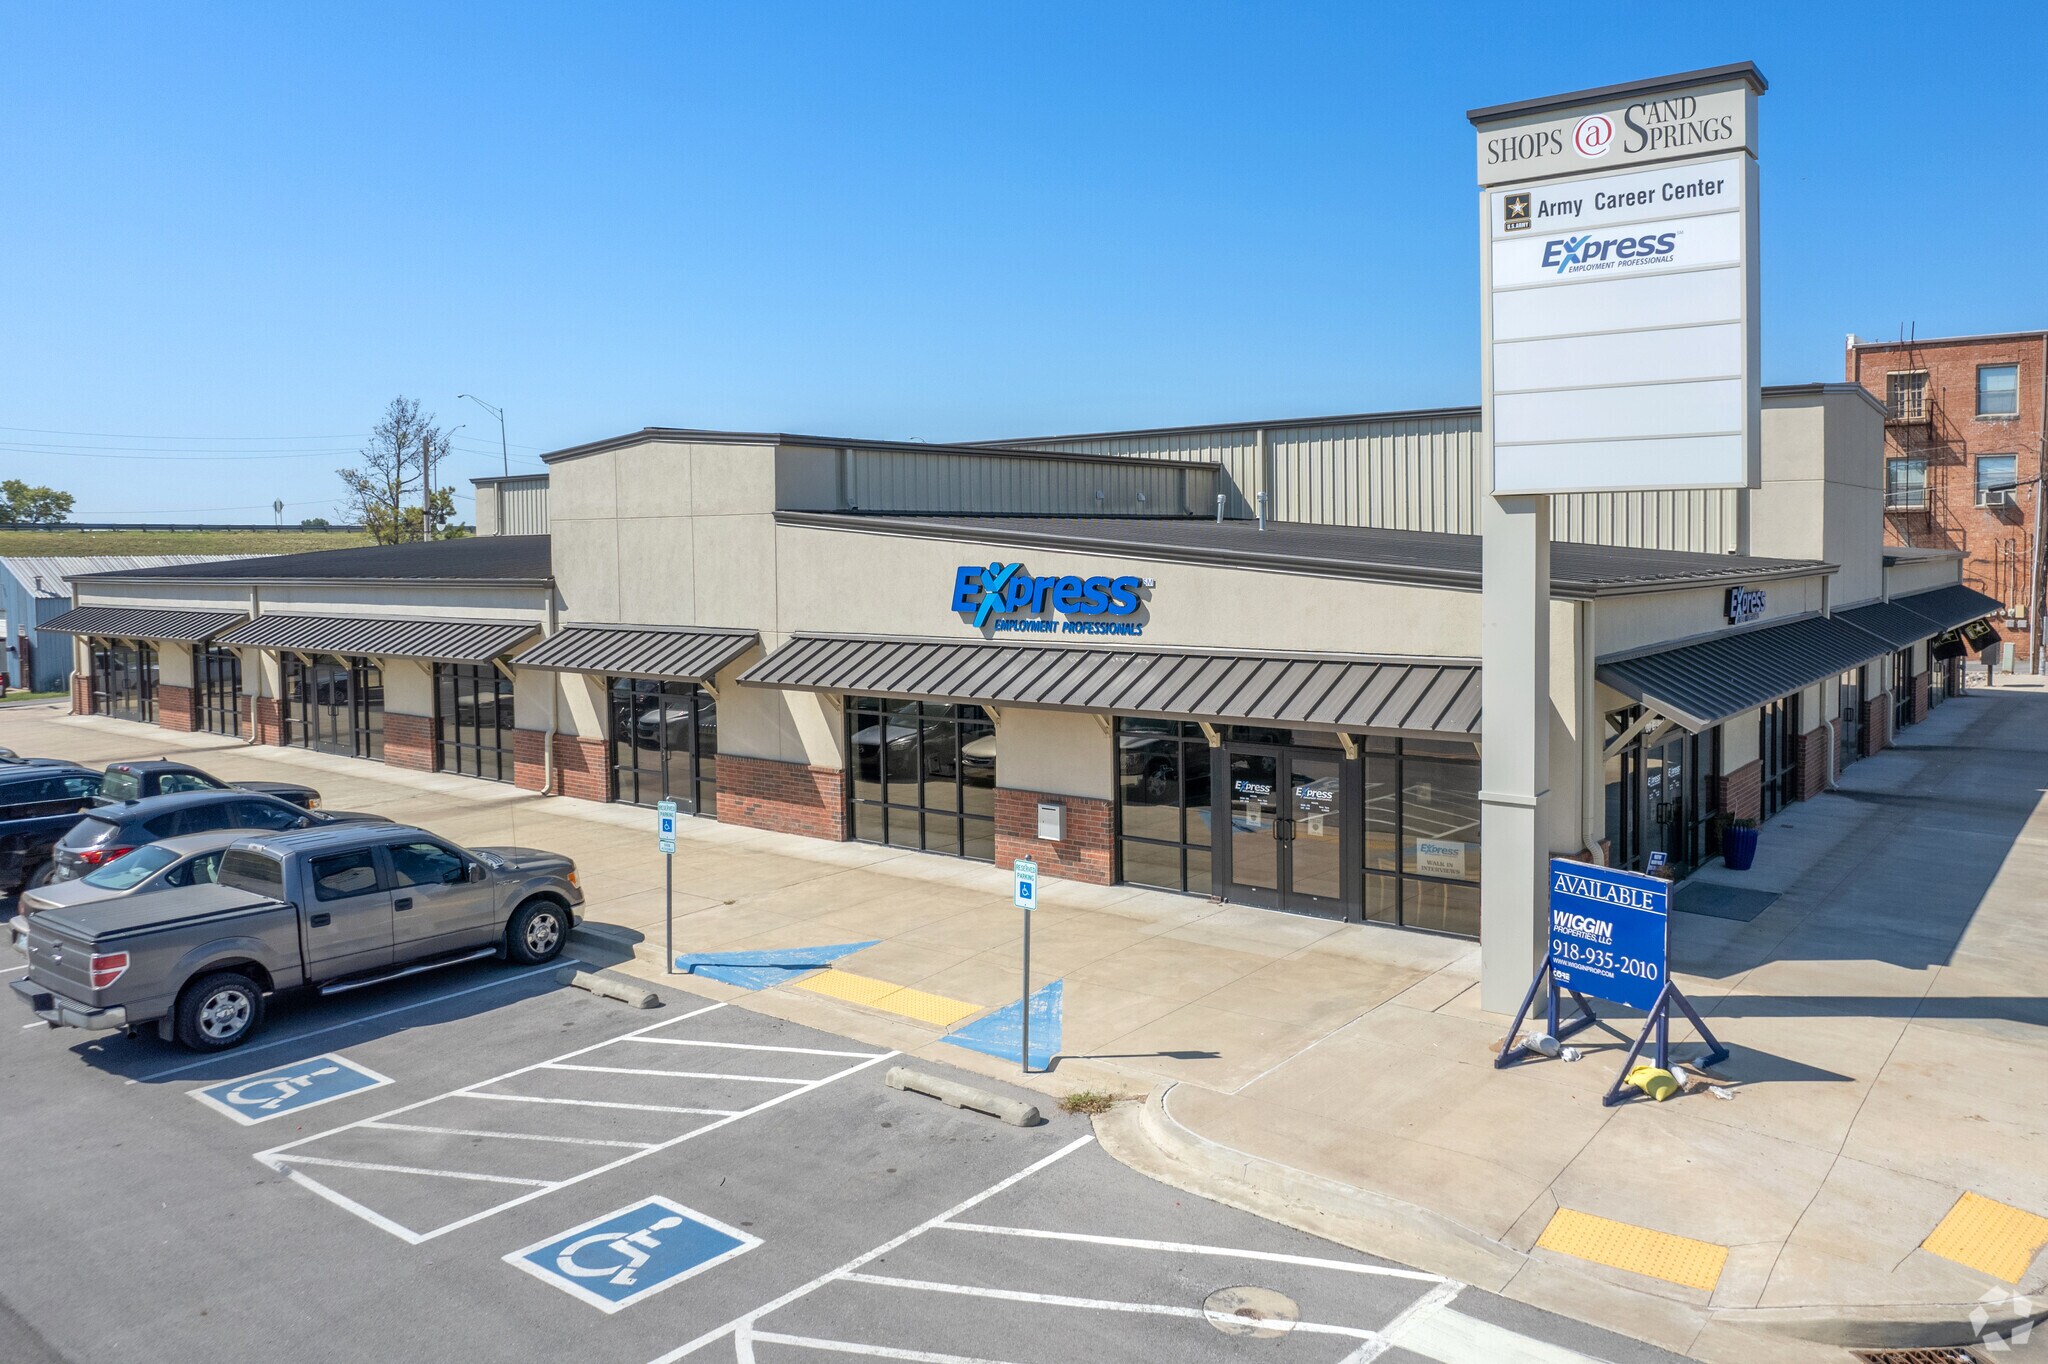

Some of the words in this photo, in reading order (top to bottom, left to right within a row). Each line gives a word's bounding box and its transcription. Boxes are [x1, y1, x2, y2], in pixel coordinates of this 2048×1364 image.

[1487, 129, 1564, 165] SHOPS
[1537, 199, 1584, 218] Army
[1594, 189, 1656, 211] Career
[1661, 178, 1725, 202] Center
[1568, 261, 1615, 274] EMPLOYMENT
[1617, 254, 1675, 268] PROFESSIONALS
[994, 619, 1059, 634] EMPLOYMENT
[1061, 620, 1143, 637] PROFESSIONALS
[1421, 865, 1462, 875] INTERVIEWS
[1426, 859, 1445, 868] WALK
[1017, 872, 1034, 881] PARKING
[1554, 874, 1654, 910] AVAILABLE
[1553, 909, 1613, 938] WIGGIN
[1553, 924, 1598, 943] PROPERTIES,
[1598, 935, 1613, 946] LLC
[1552, 938, 1658, 981] 918-935-2010
[1552, 957, 1615, 979] WWW.WIGGINPROP.COM
